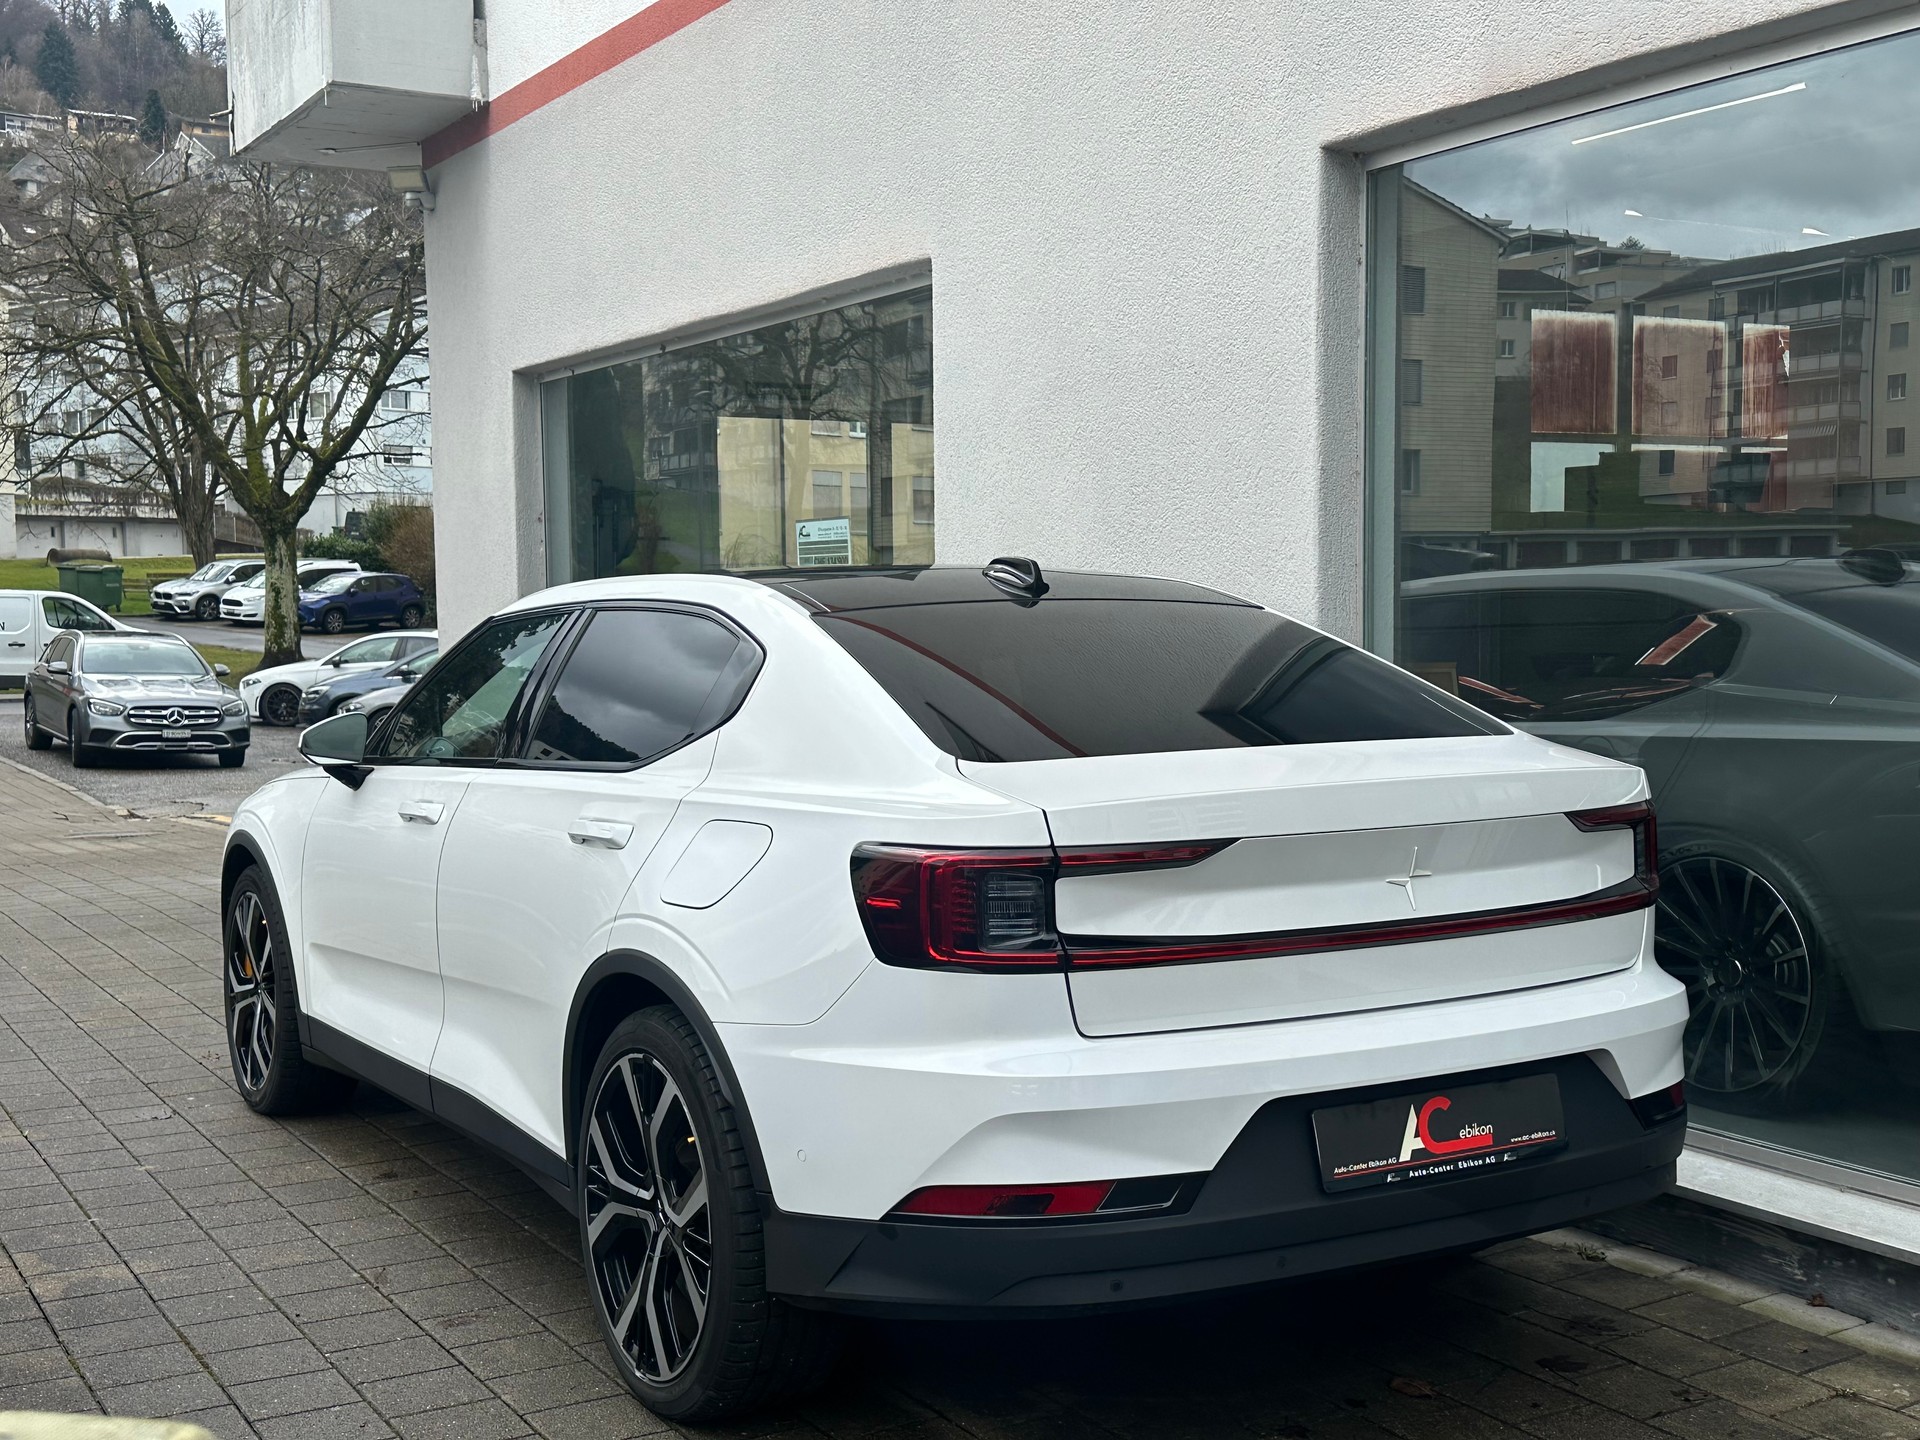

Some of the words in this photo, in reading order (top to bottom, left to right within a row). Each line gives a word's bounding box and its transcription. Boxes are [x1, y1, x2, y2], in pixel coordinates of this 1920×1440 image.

[1399, 1096, 1493, 1162] AC
[1459, 1123, 1493, 1139] ebikon
[1334, 1164, 1368, 1174] Auto-Center
[1368, 1160, 1387, 1168] Ebikon
[1409, 1164, 1454, 1178] Auto-Center
[1458, 1159, 1482, 1169] Ebikon
[1485, 1155, 1496, 1164] AG
